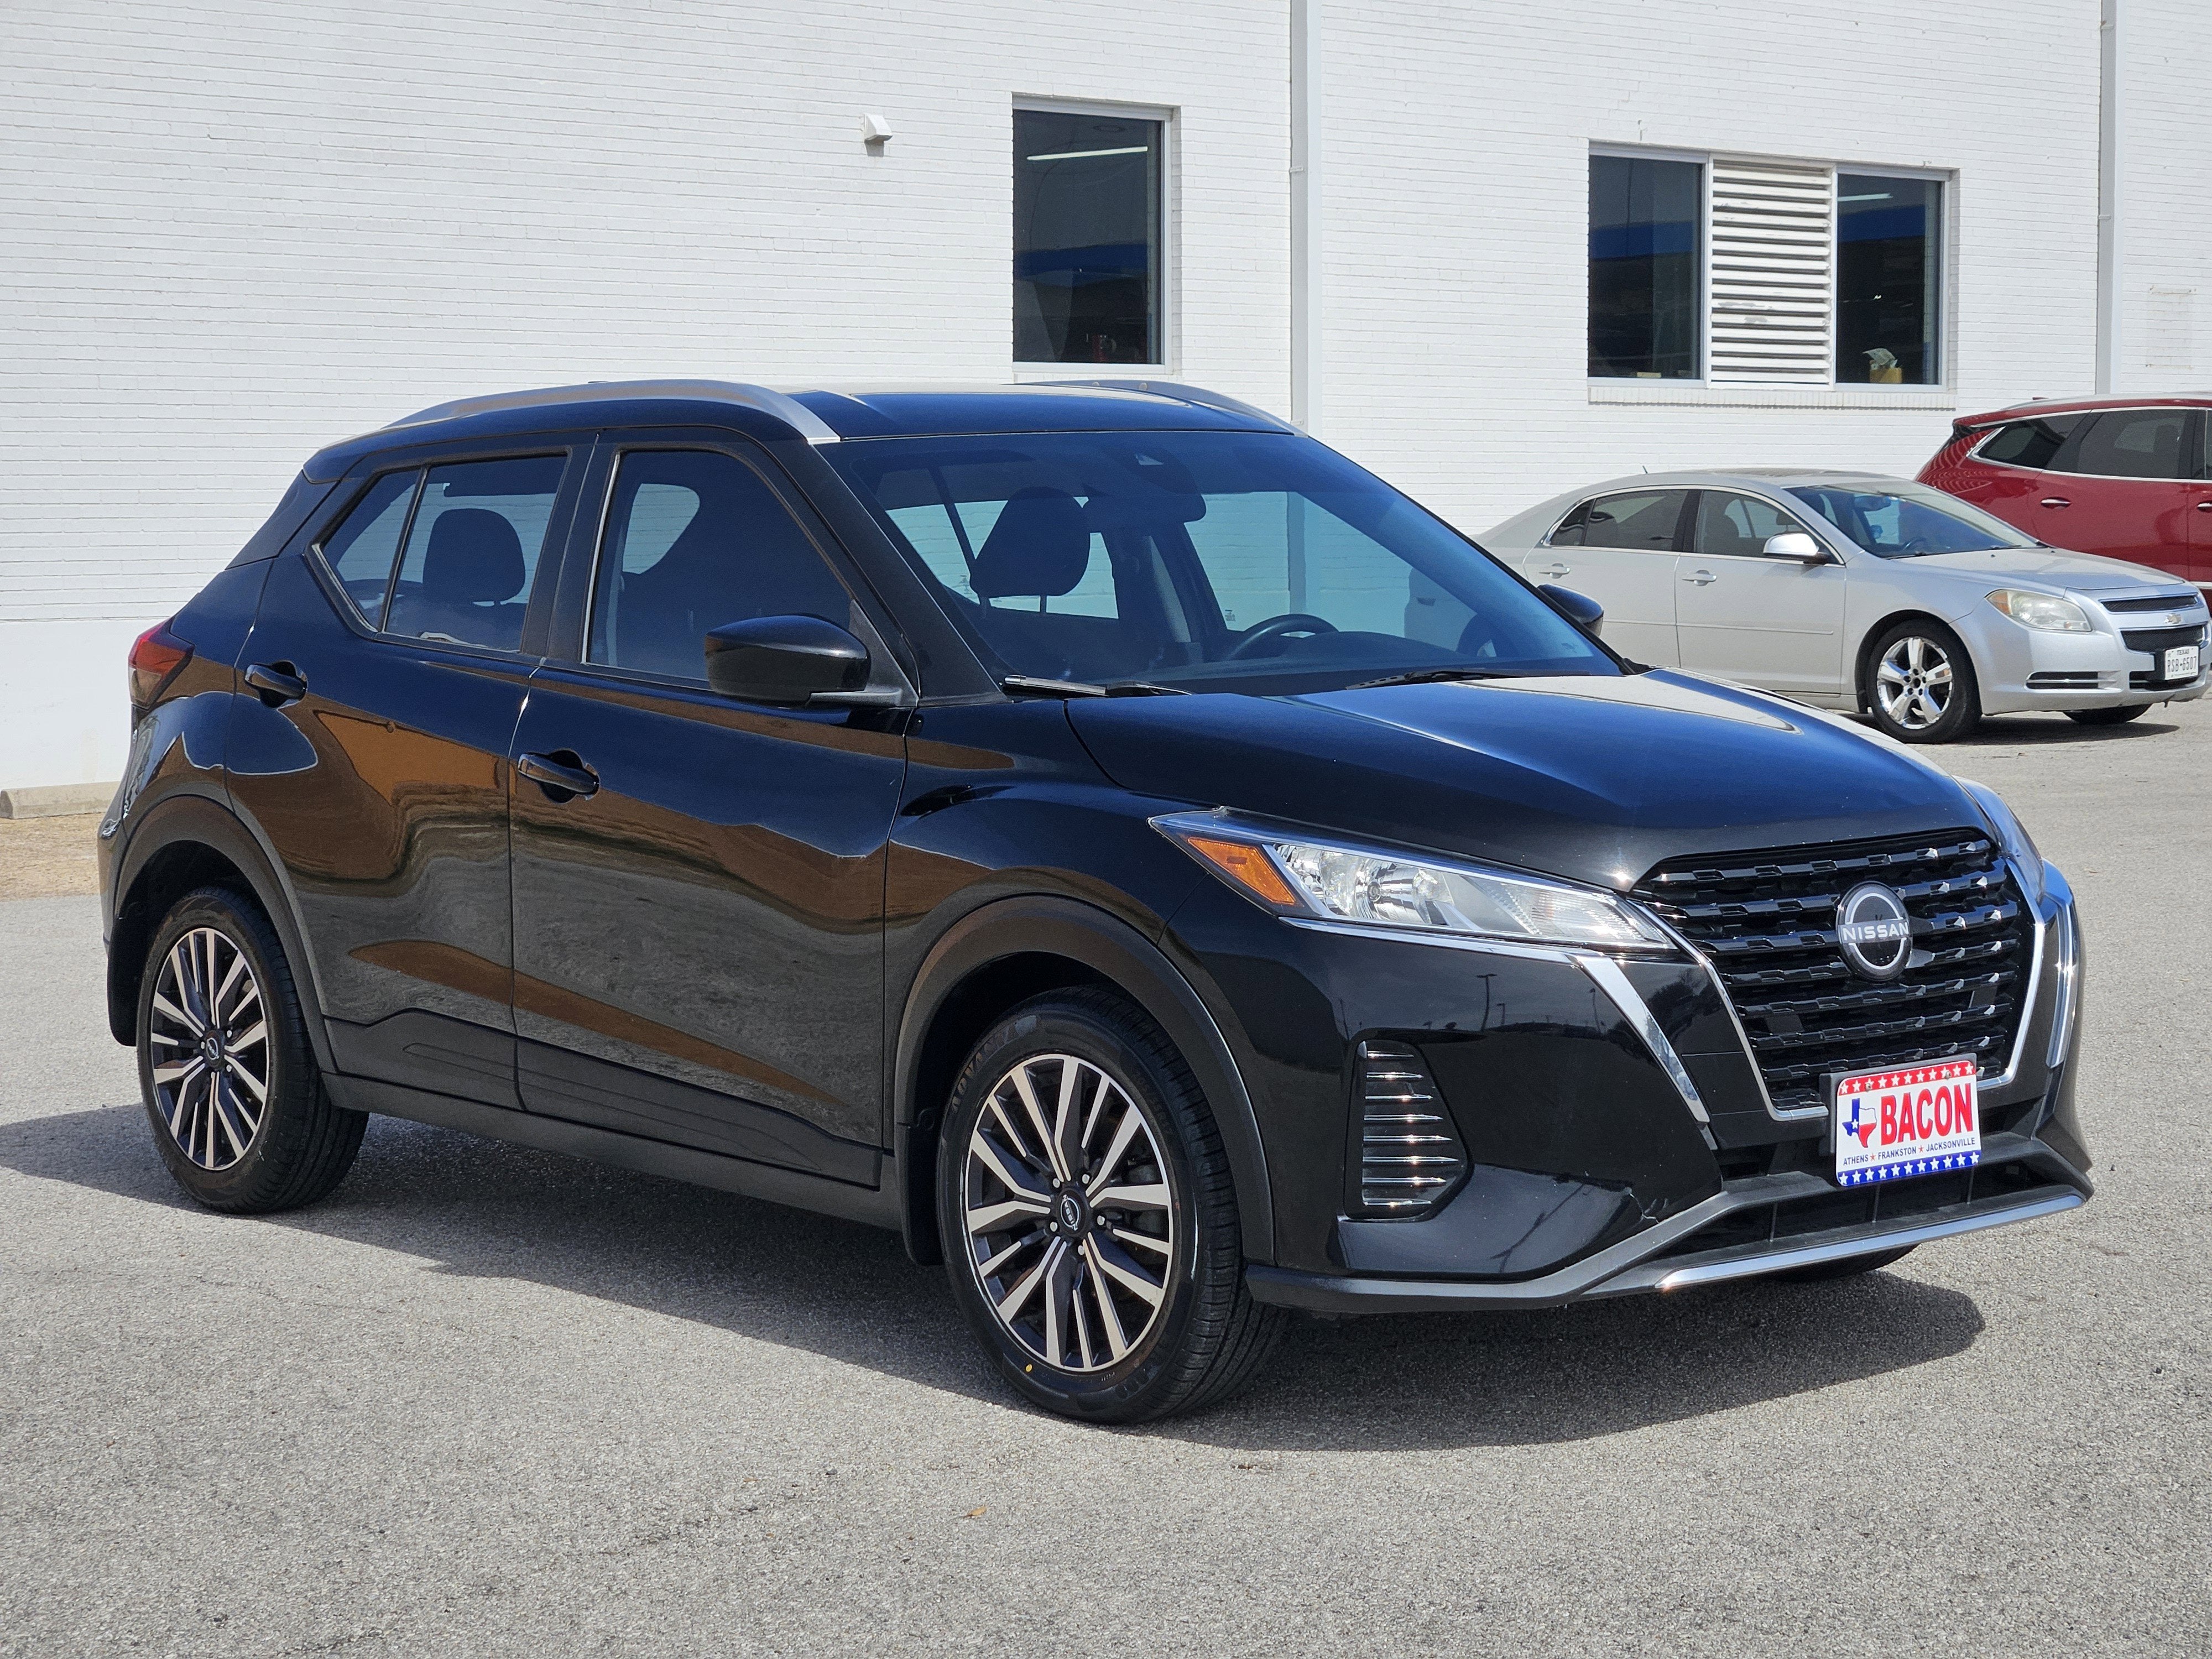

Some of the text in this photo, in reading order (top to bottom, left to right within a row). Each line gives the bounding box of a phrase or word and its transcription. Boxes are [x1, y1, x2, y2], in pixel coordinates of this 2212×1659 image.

[1842, 922, 1909, 941] NISSAN
[1881, 1083, 1973, 1146] BACON
[1843, 1138, 1975, 1166] ATHENS FRANKSTON JACKSONVILLE
